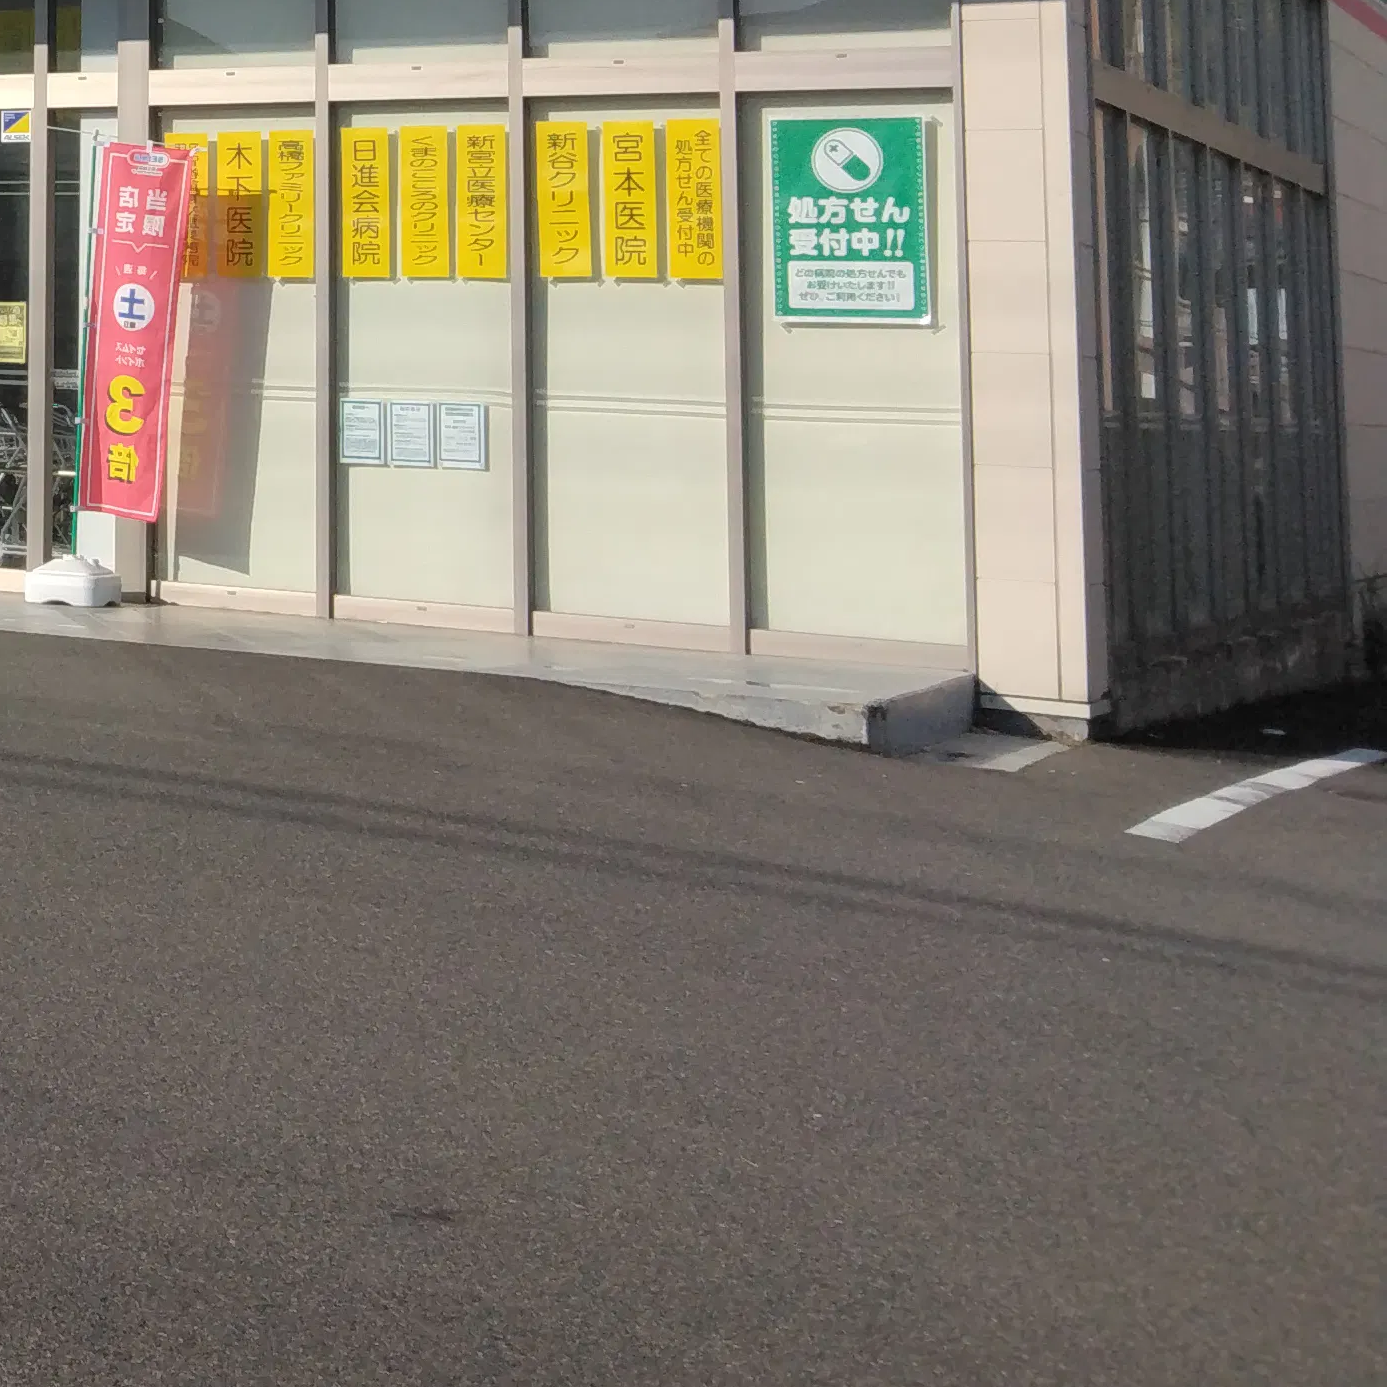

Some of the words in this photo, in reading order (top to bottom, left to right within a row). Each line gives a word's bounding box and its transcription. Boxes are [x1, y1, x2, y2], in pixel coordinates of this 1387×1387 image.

[226, 142, 254, 267] 木下医院
[351, 139, 382, 266] 日進会病院
[547, 132, 579, 266] 新谷クリニック
[612, 132, 647, 267] 宮本医院
[675, 139, 694, 258] 処方せん受付中
[694, 129, 716, 267] 全ての医療機関の
[787, 195, 911, 224] 処方せん
